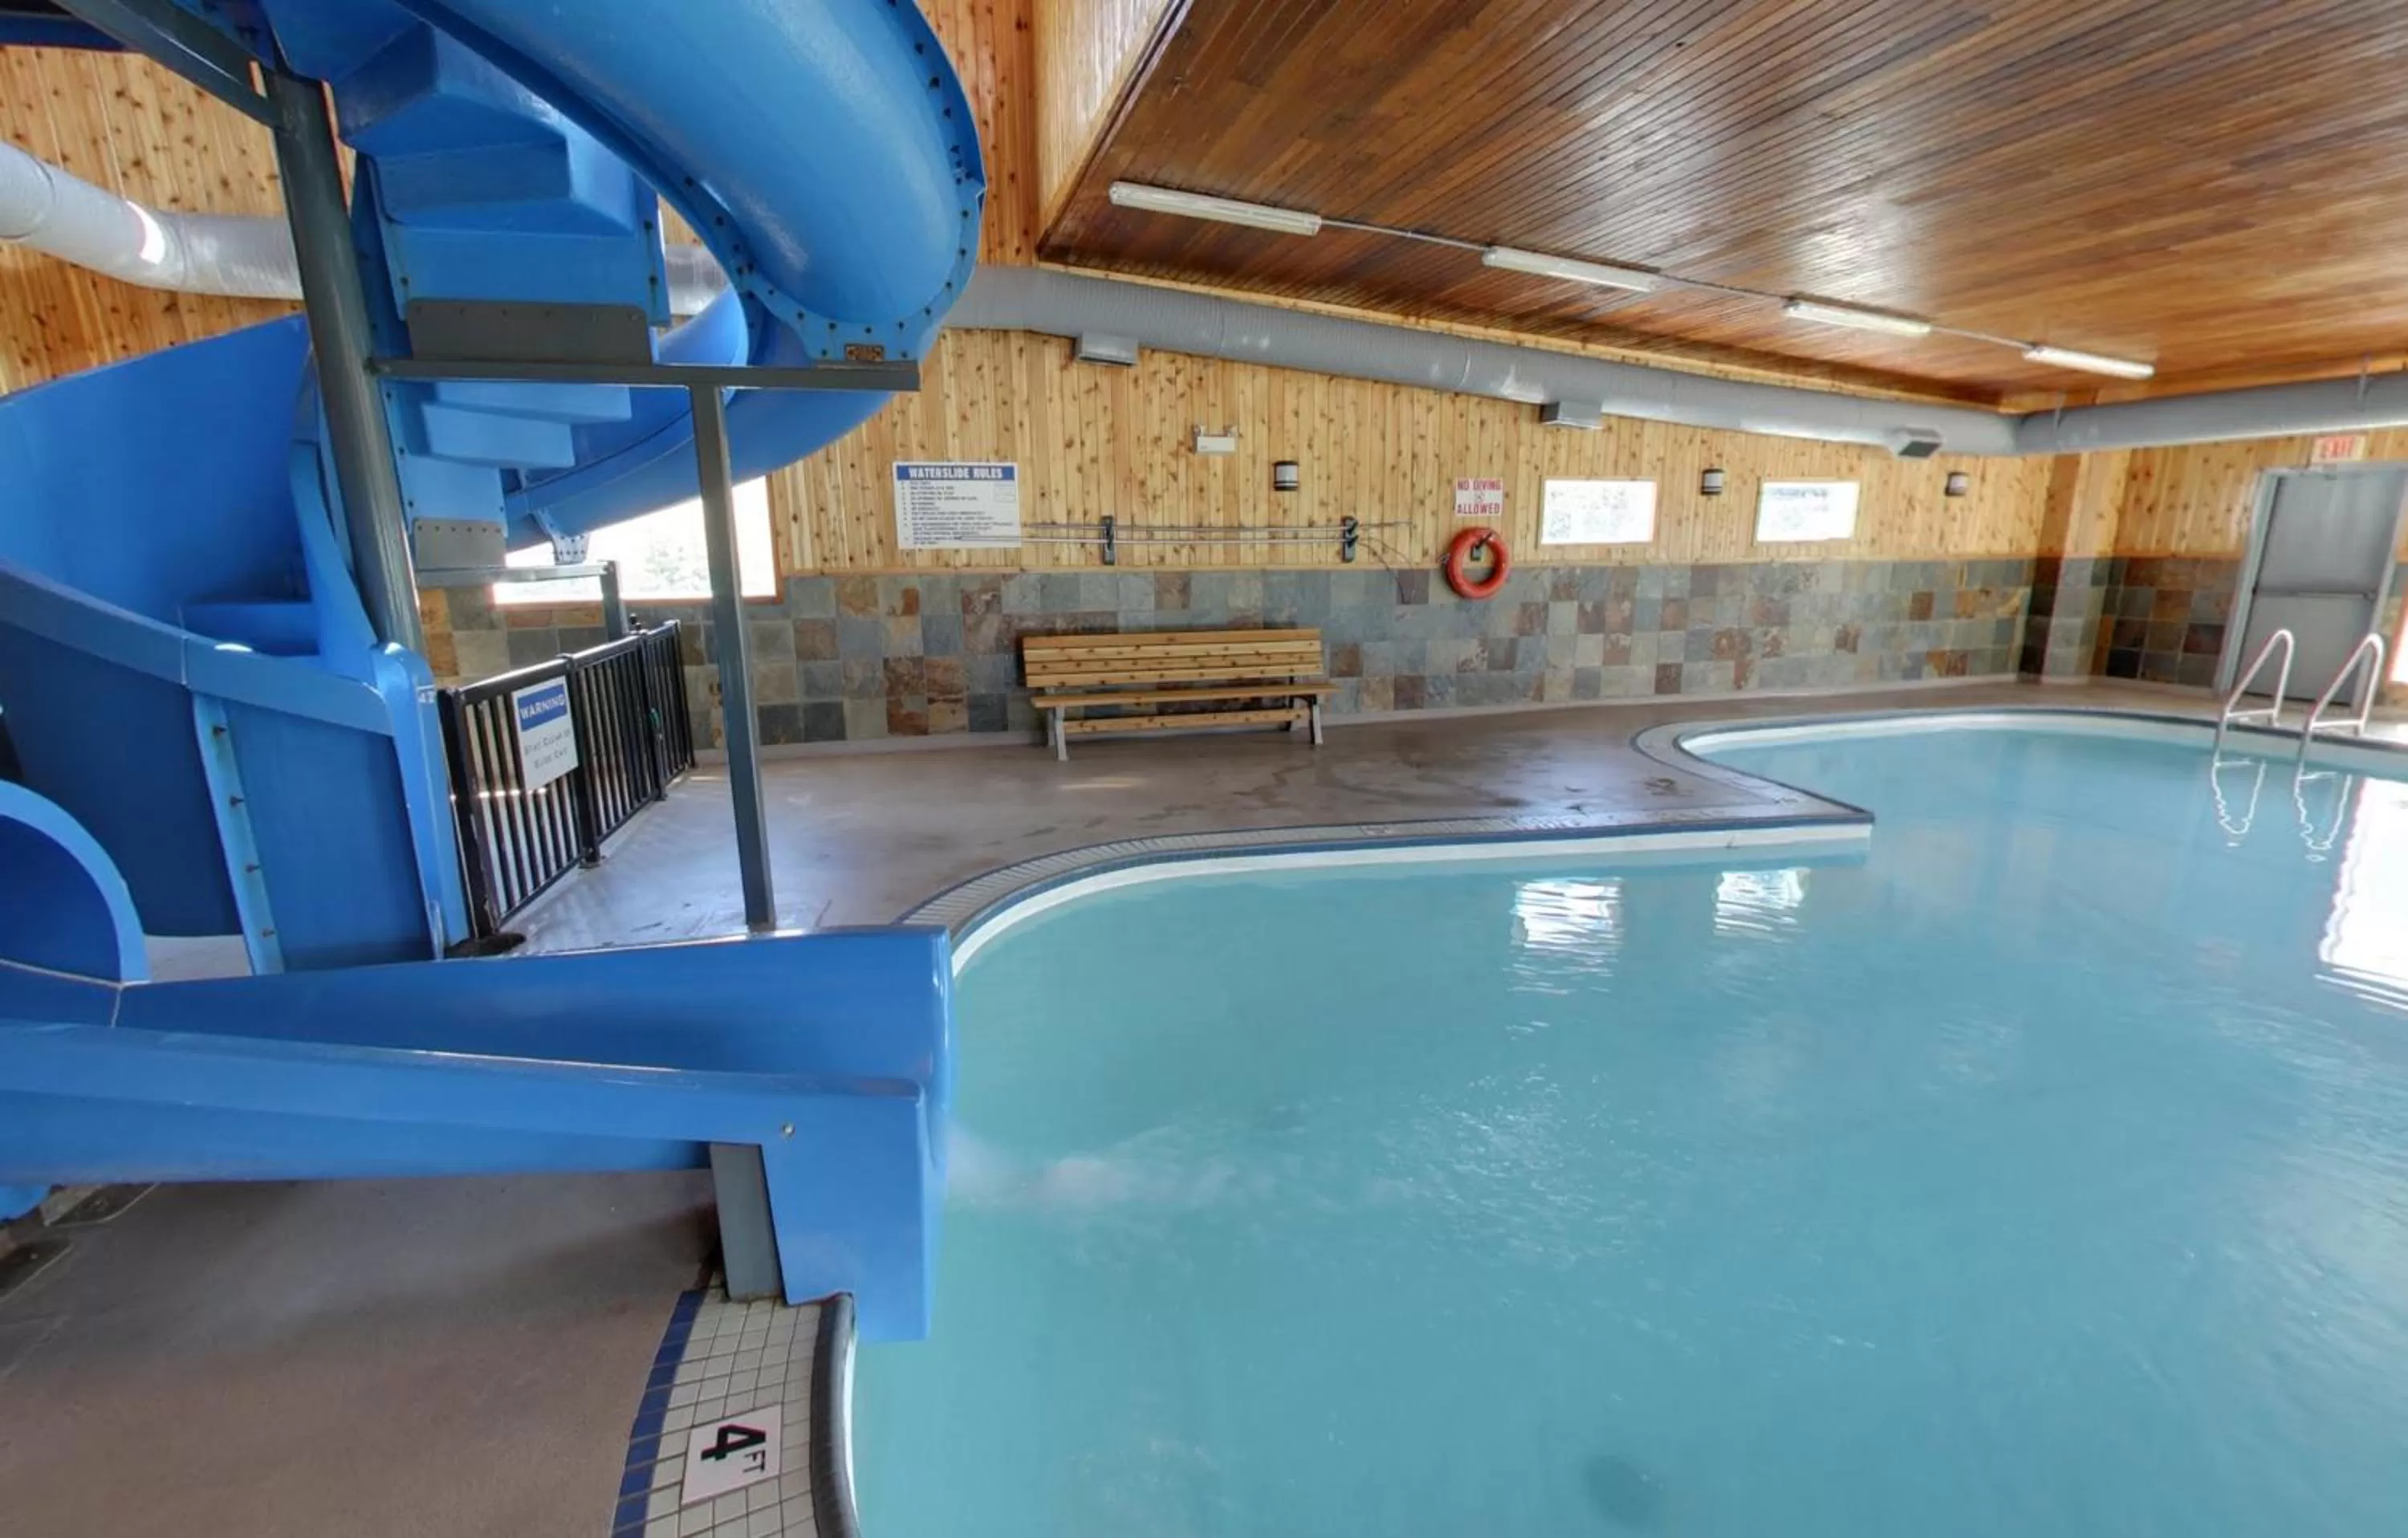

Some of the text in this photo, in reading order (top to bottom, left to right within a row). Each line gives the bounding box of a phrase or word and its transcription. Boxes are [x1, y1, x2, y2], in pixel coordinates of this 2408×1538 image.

[909, 466, 1003, 479] WATERSLIDE RULES
[1457, 479, 1502, 491] NO DIVING
[1457, 502, 1501, 515] ALLOWED
[519, 693, 566, 720] WARNING
[701, 1424, 766, 1473] 4 FT
